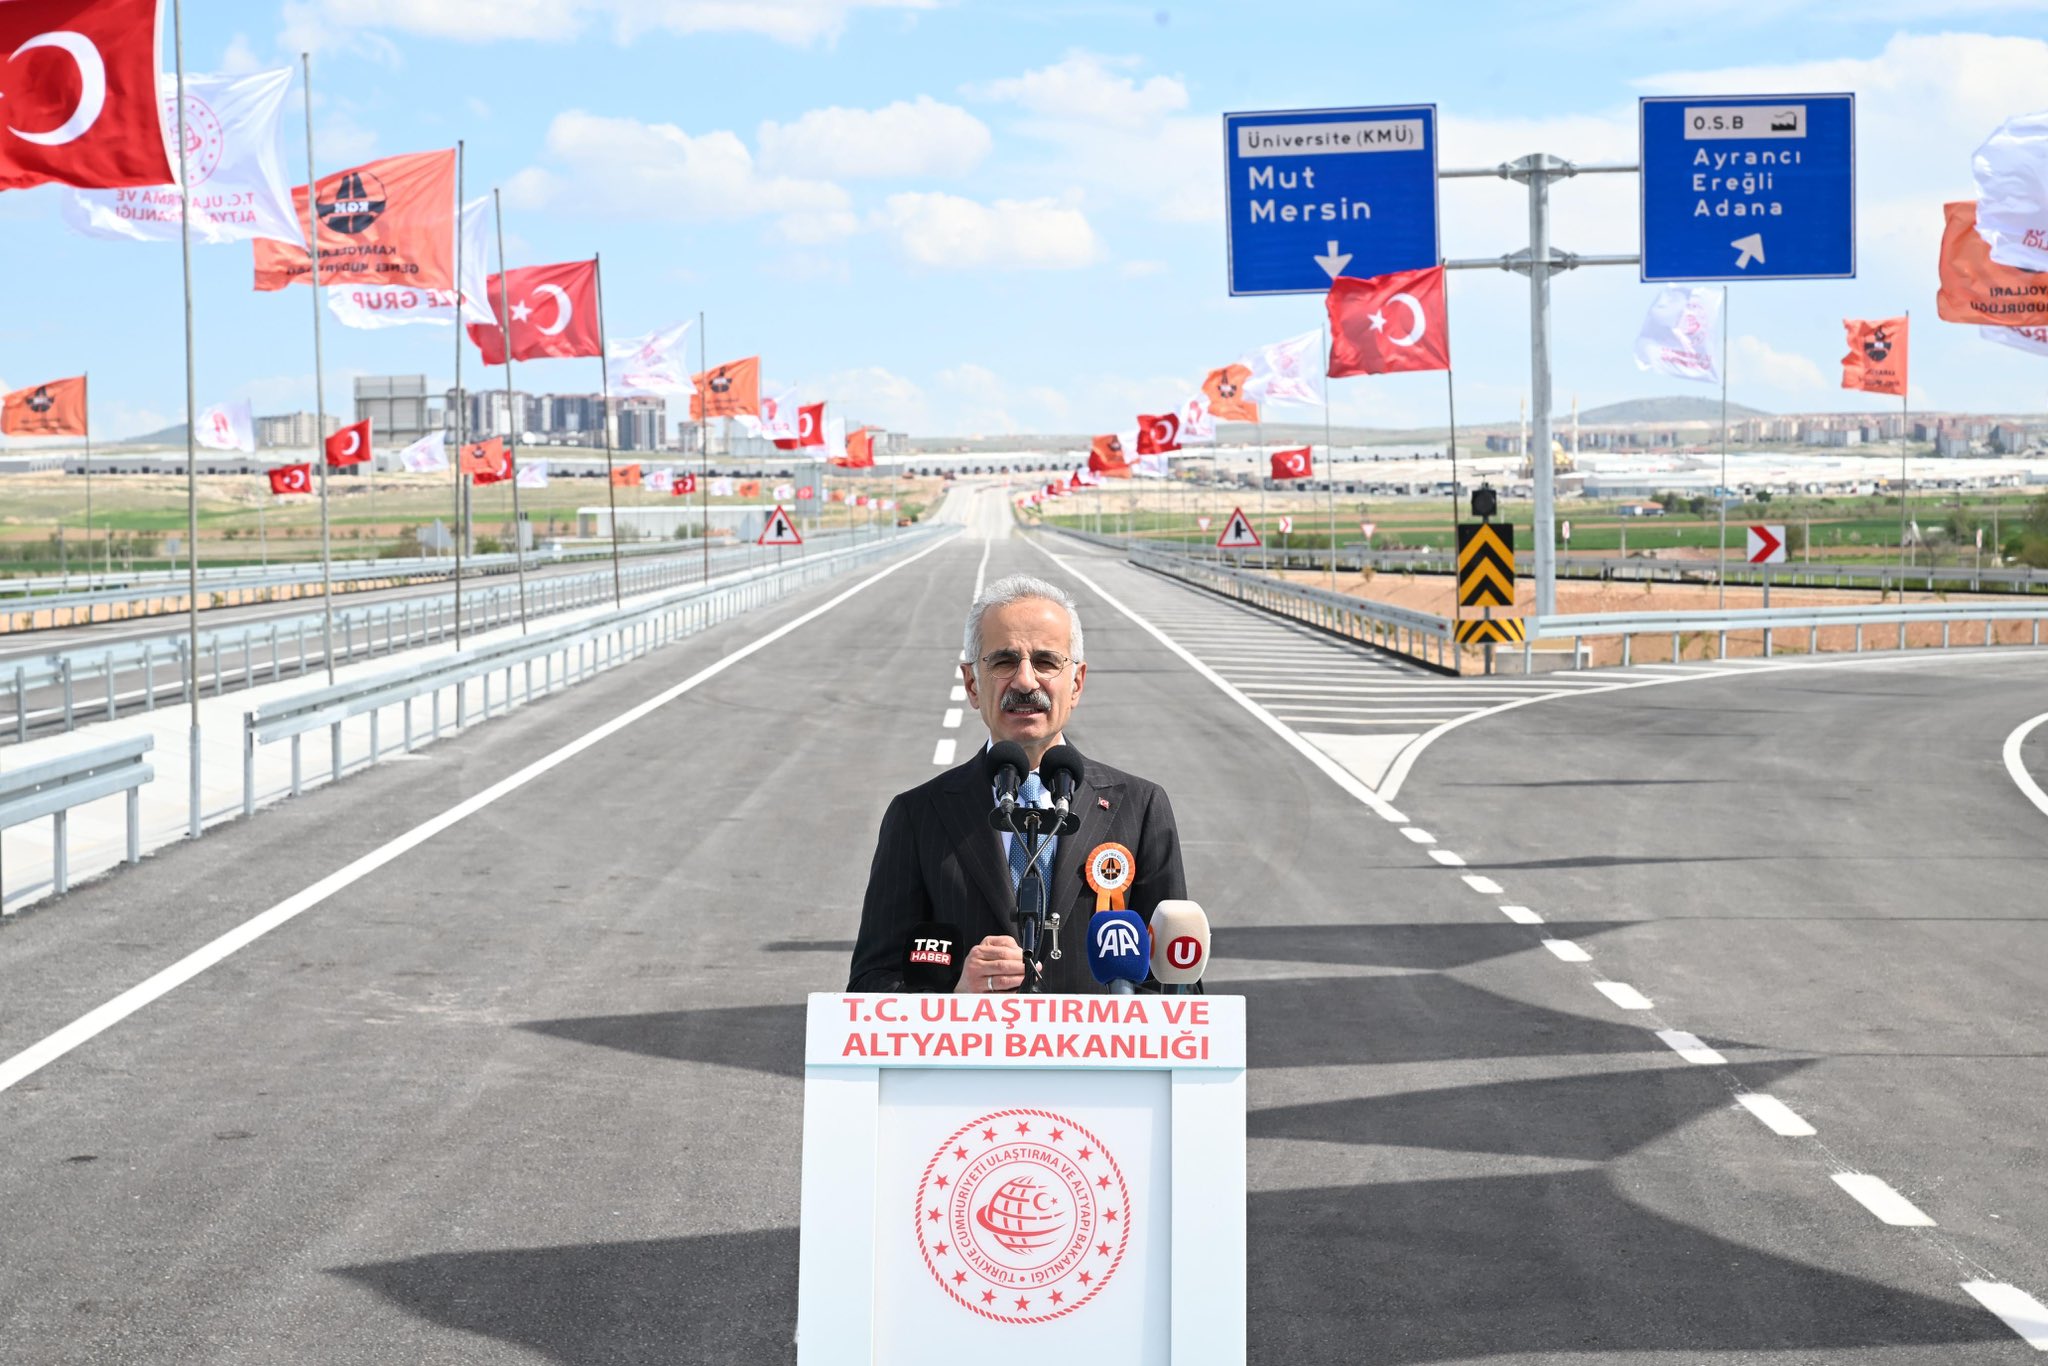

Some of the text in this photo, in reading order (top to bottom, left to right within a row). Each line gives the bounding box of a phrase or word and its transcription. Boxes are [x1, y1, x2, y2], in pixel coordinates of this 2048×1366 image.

[1693, 116, 1744, 130] O.S.B
[1248, 125, 1414, 148] Üniversite (KMÜ)
[1693, 147, 1801, 170] Ayrancı
[1249, 165, 1315, 191] Mut
[1693, 172, 1773, 195] Ereğli
[1250, 197, 1371, 224] Mersin
[1694, 198, 1782, 217] Adana
[914, 938, 952, 953] TRT
[1099, 928, 1140, 958] AA
[1174, 942, 1196, 965] U
[912, 952, 950, 964] HABER
[843, 998, 1209, 1030] T.C. ULAŞTIRMA VE
[842, 1030, 1209, 1060] ALTYAPI BAKANLIĞI
[955, 1148, 1091, 1284] TÜRKİYE CUMHURİYETİ ULAŞTIRMA VE ALTYAPI BAKANLIĞI
